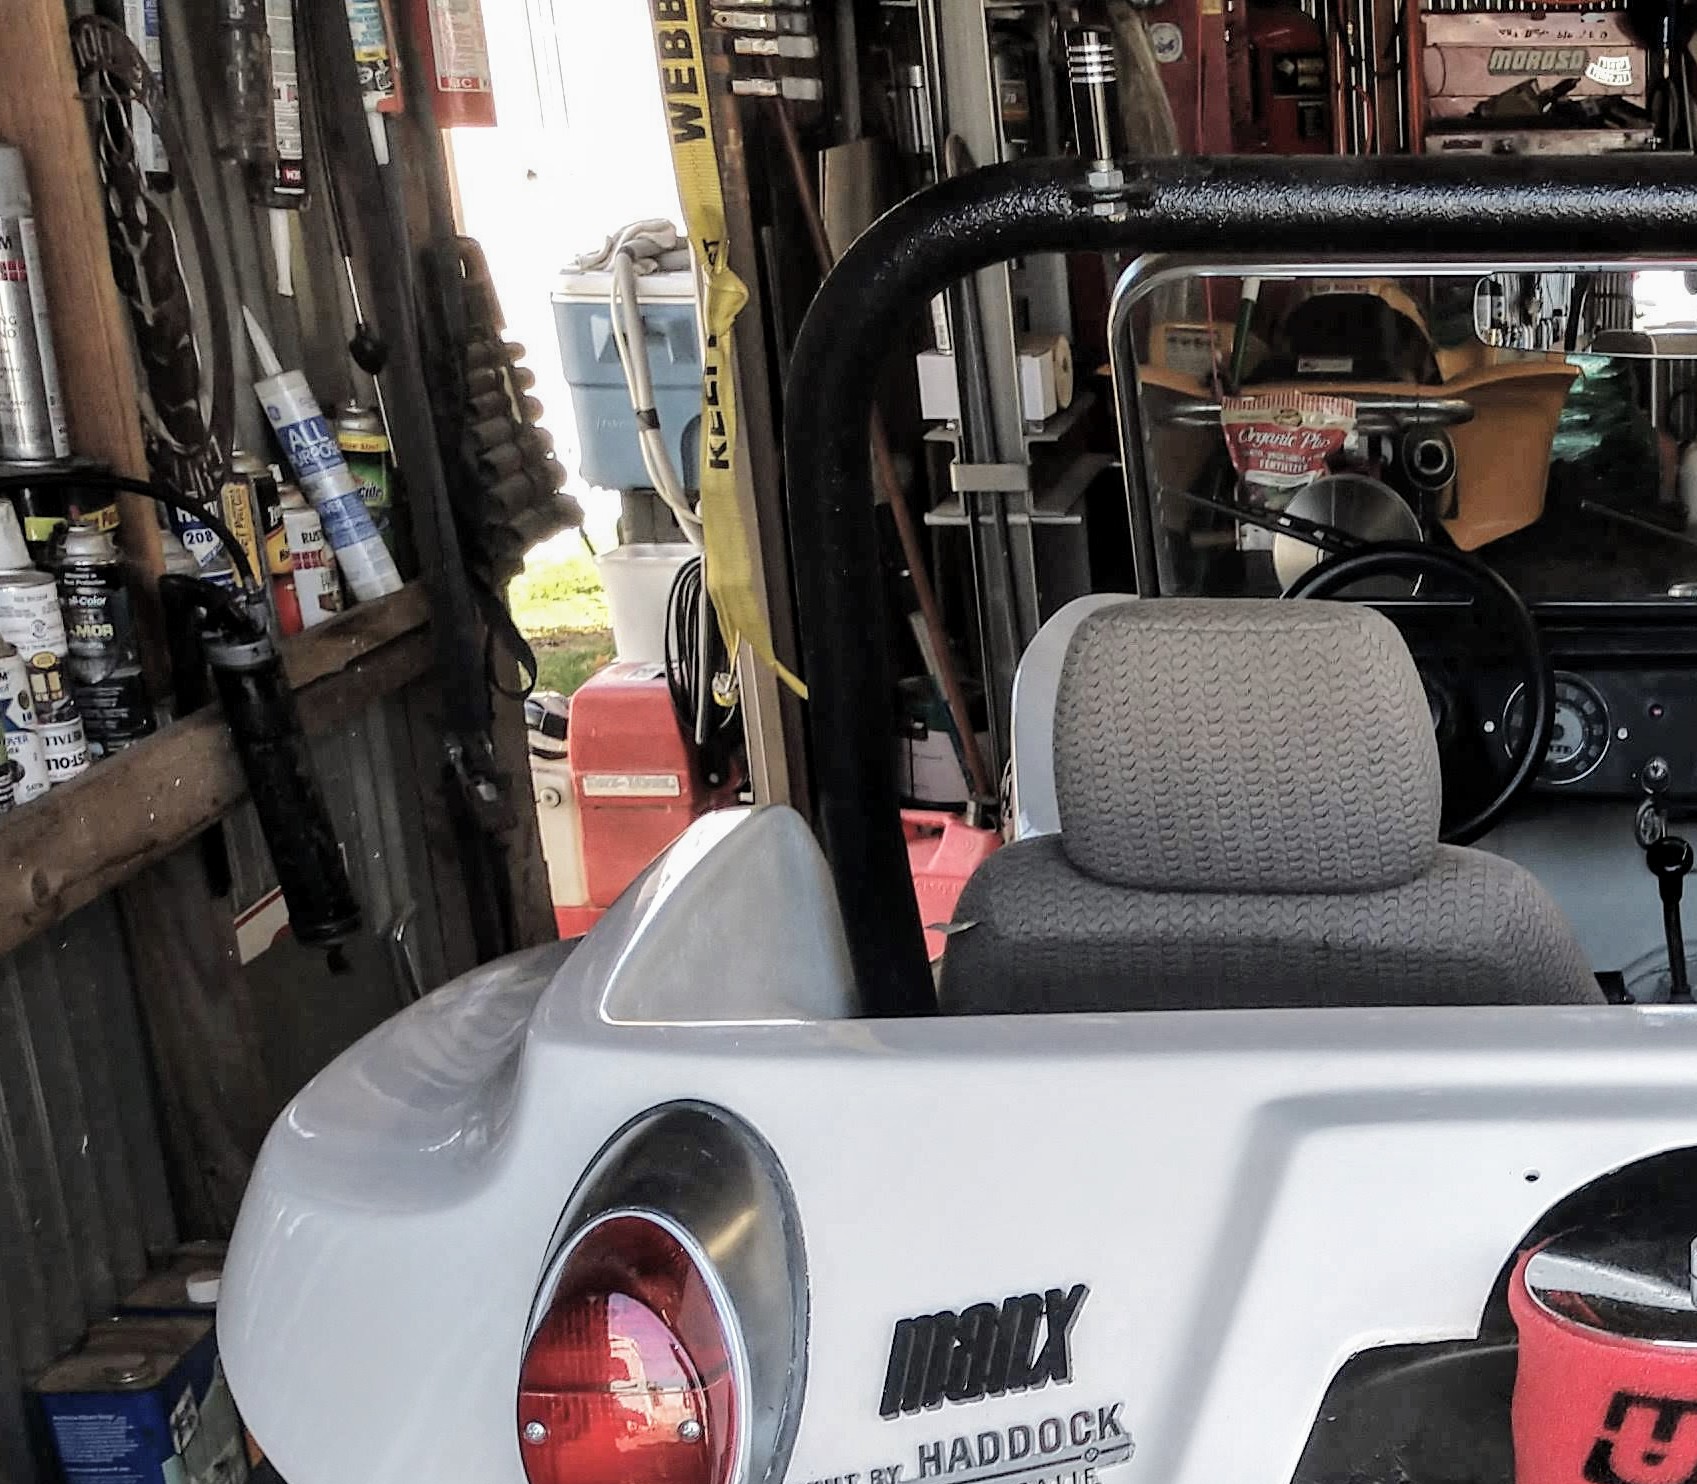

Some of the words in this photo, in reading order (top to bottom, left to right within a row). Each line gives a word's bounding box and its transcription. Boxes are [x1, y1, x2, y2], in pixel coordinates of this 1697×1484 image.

[1489, 48, 1588, 75] MOROSO
[288, 420, 329, 453] ALL
[1239, 426, 1297, 448] Organic
[186, 529, 214, 545] 208
[879, 1283, 1090, 1420] MANX
[918, 1403, 1128, 1479] HADDOCK
